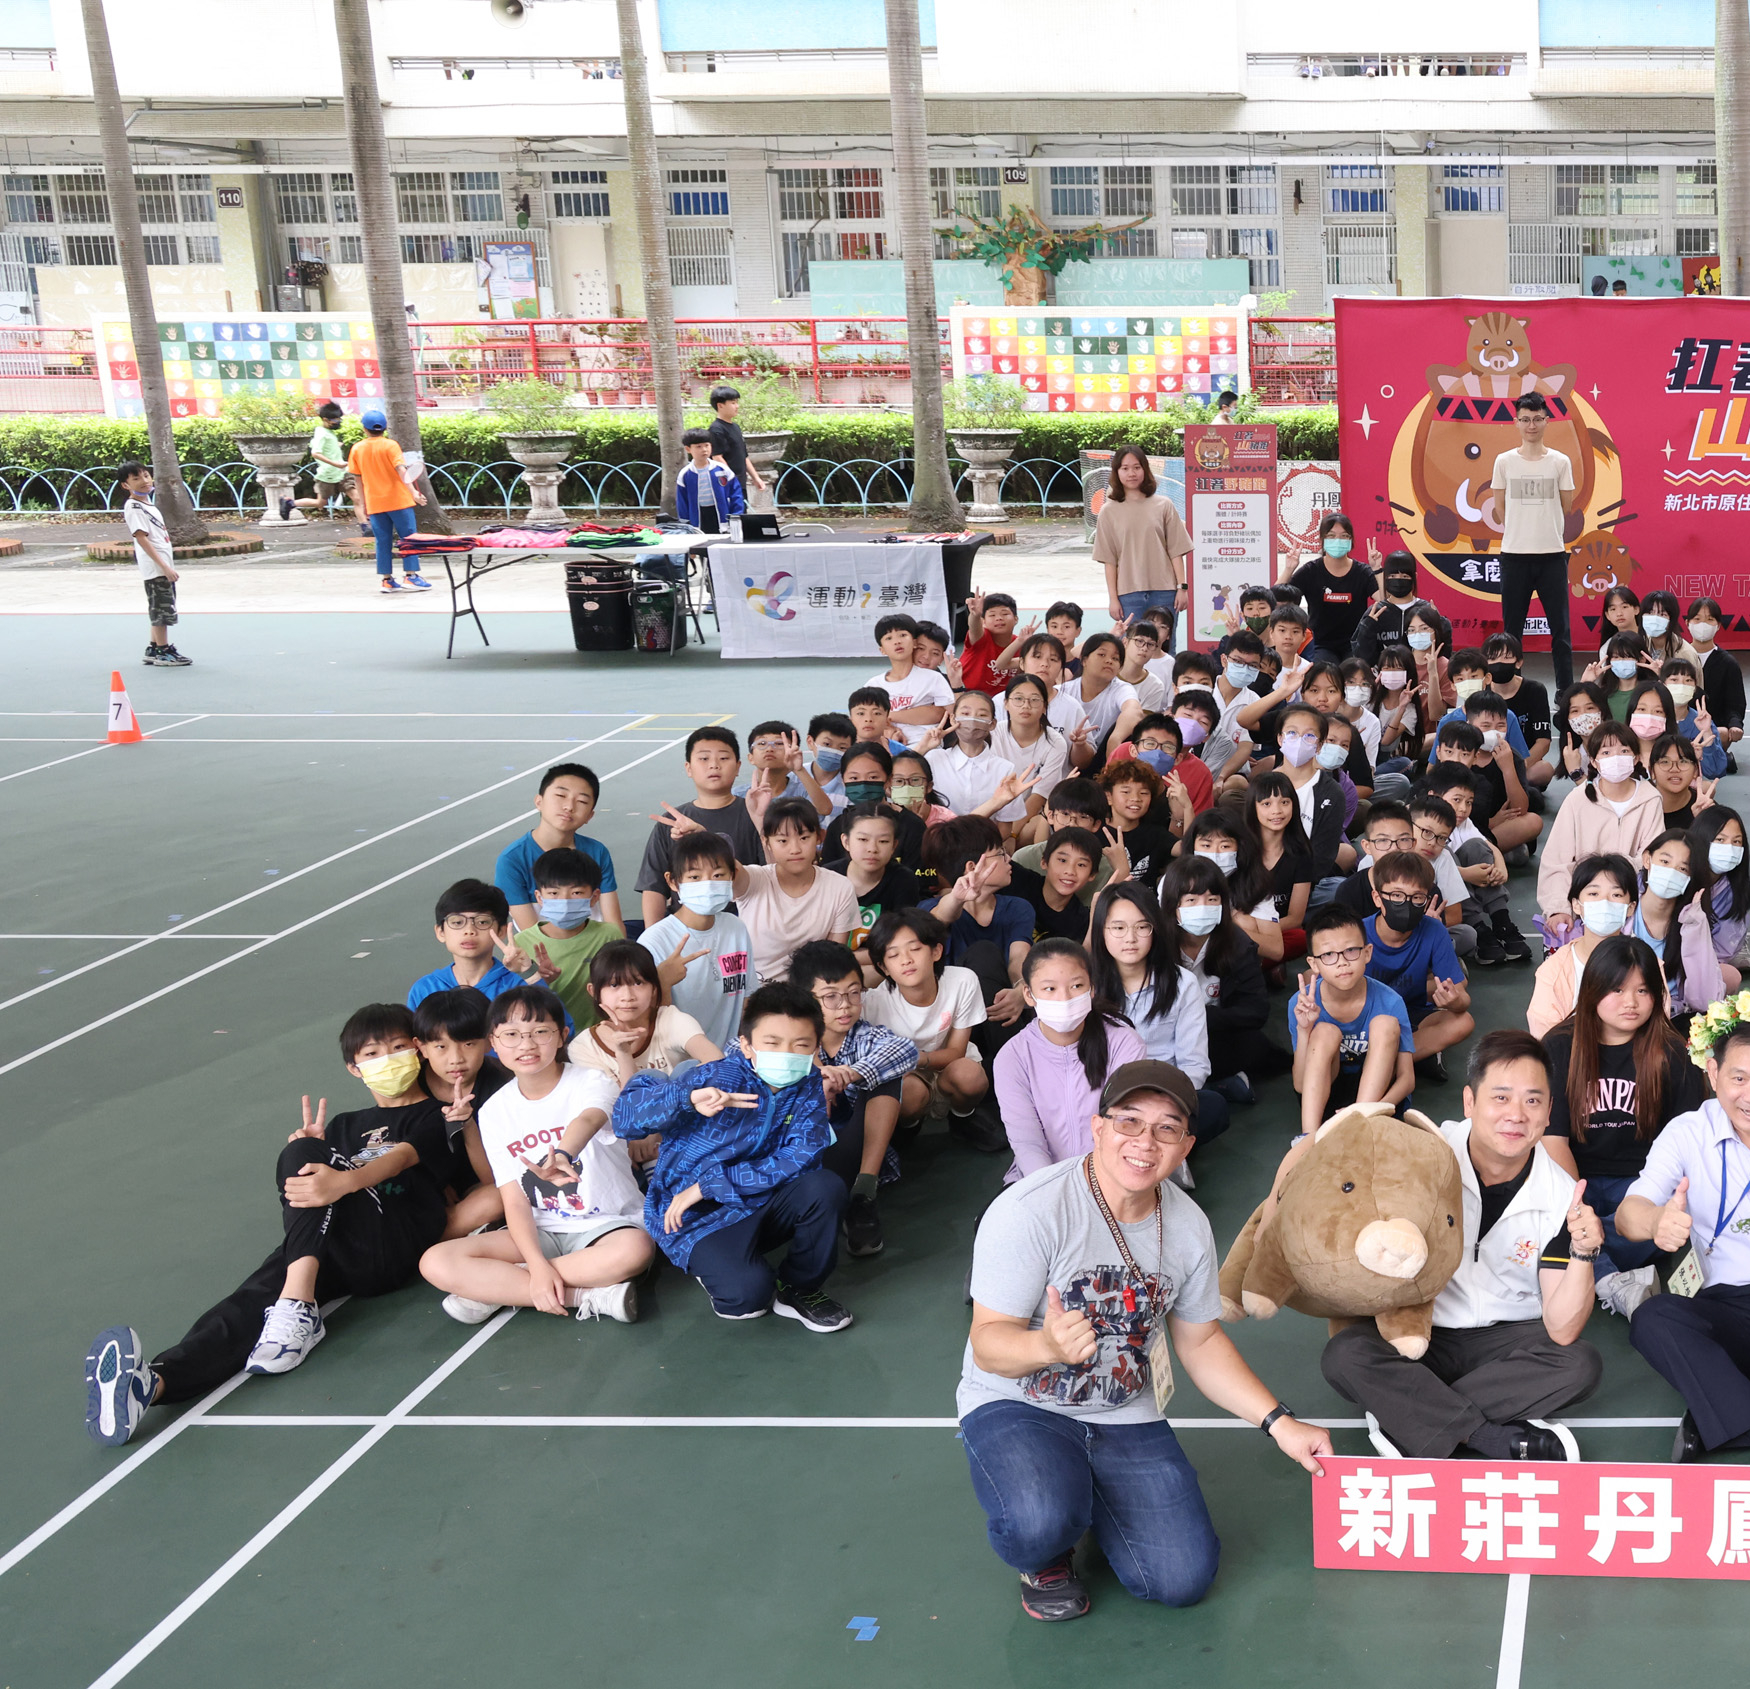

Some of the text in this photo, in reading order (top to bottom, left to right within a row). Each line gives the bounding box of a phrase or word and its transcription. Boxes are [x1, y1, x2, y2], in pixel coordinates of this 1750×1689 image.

[1006, 169, 1025, 180] 109
[219, 192, 239, 203] 110
[1195, 477, 1267, 491] 扛著野豬跑
[1664, 574, 1725, 597] NEW
[112, 703, 122, 720] 7
[914, 868, 936, 876] A-OK
